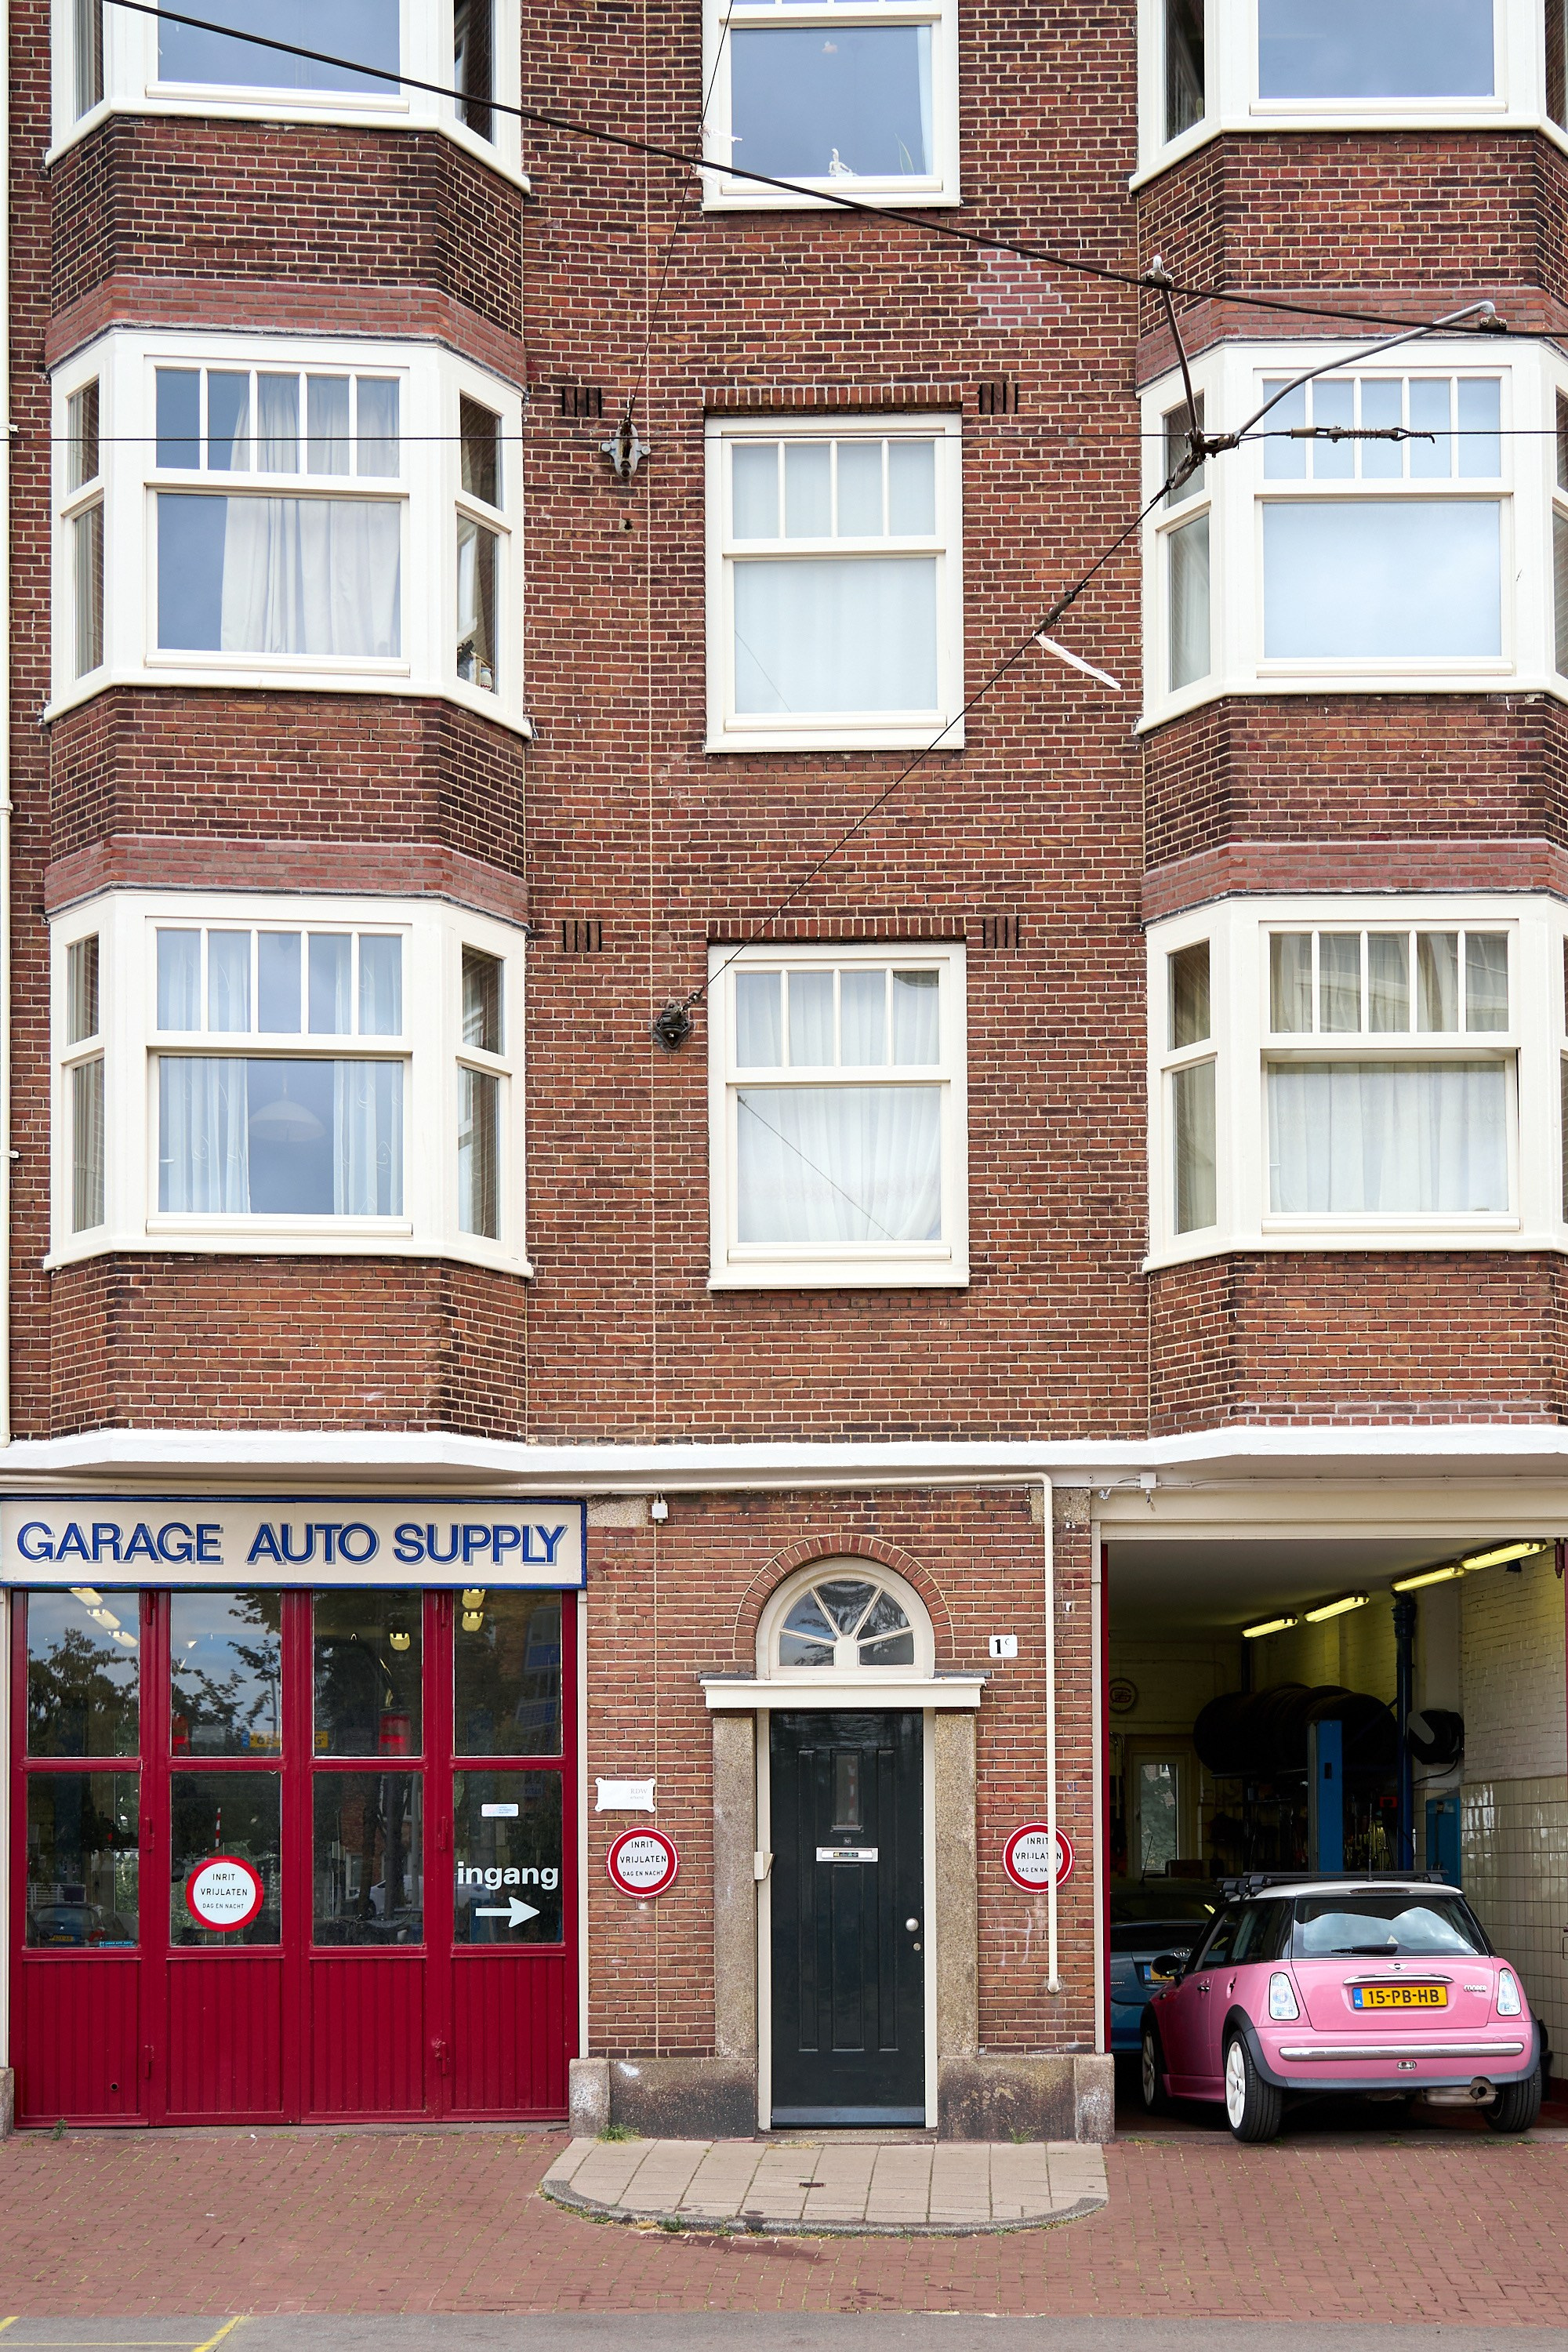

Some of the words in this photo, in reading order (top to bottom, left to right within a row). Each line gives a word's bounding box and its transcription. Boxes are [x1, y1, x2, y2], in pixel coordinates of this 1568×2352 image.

[16, 1521, 223, 1564] GARAGE
[245, 1522, 380, 1565] AUTO
[393, 1523, 568, 1566] SUPPLY
[619, 1855, 666, 1864] VRIJLATEN
[457, 1860, 559, 1890] ingang
[1368, 1989, 1440, 2005] 15-PB-HB
